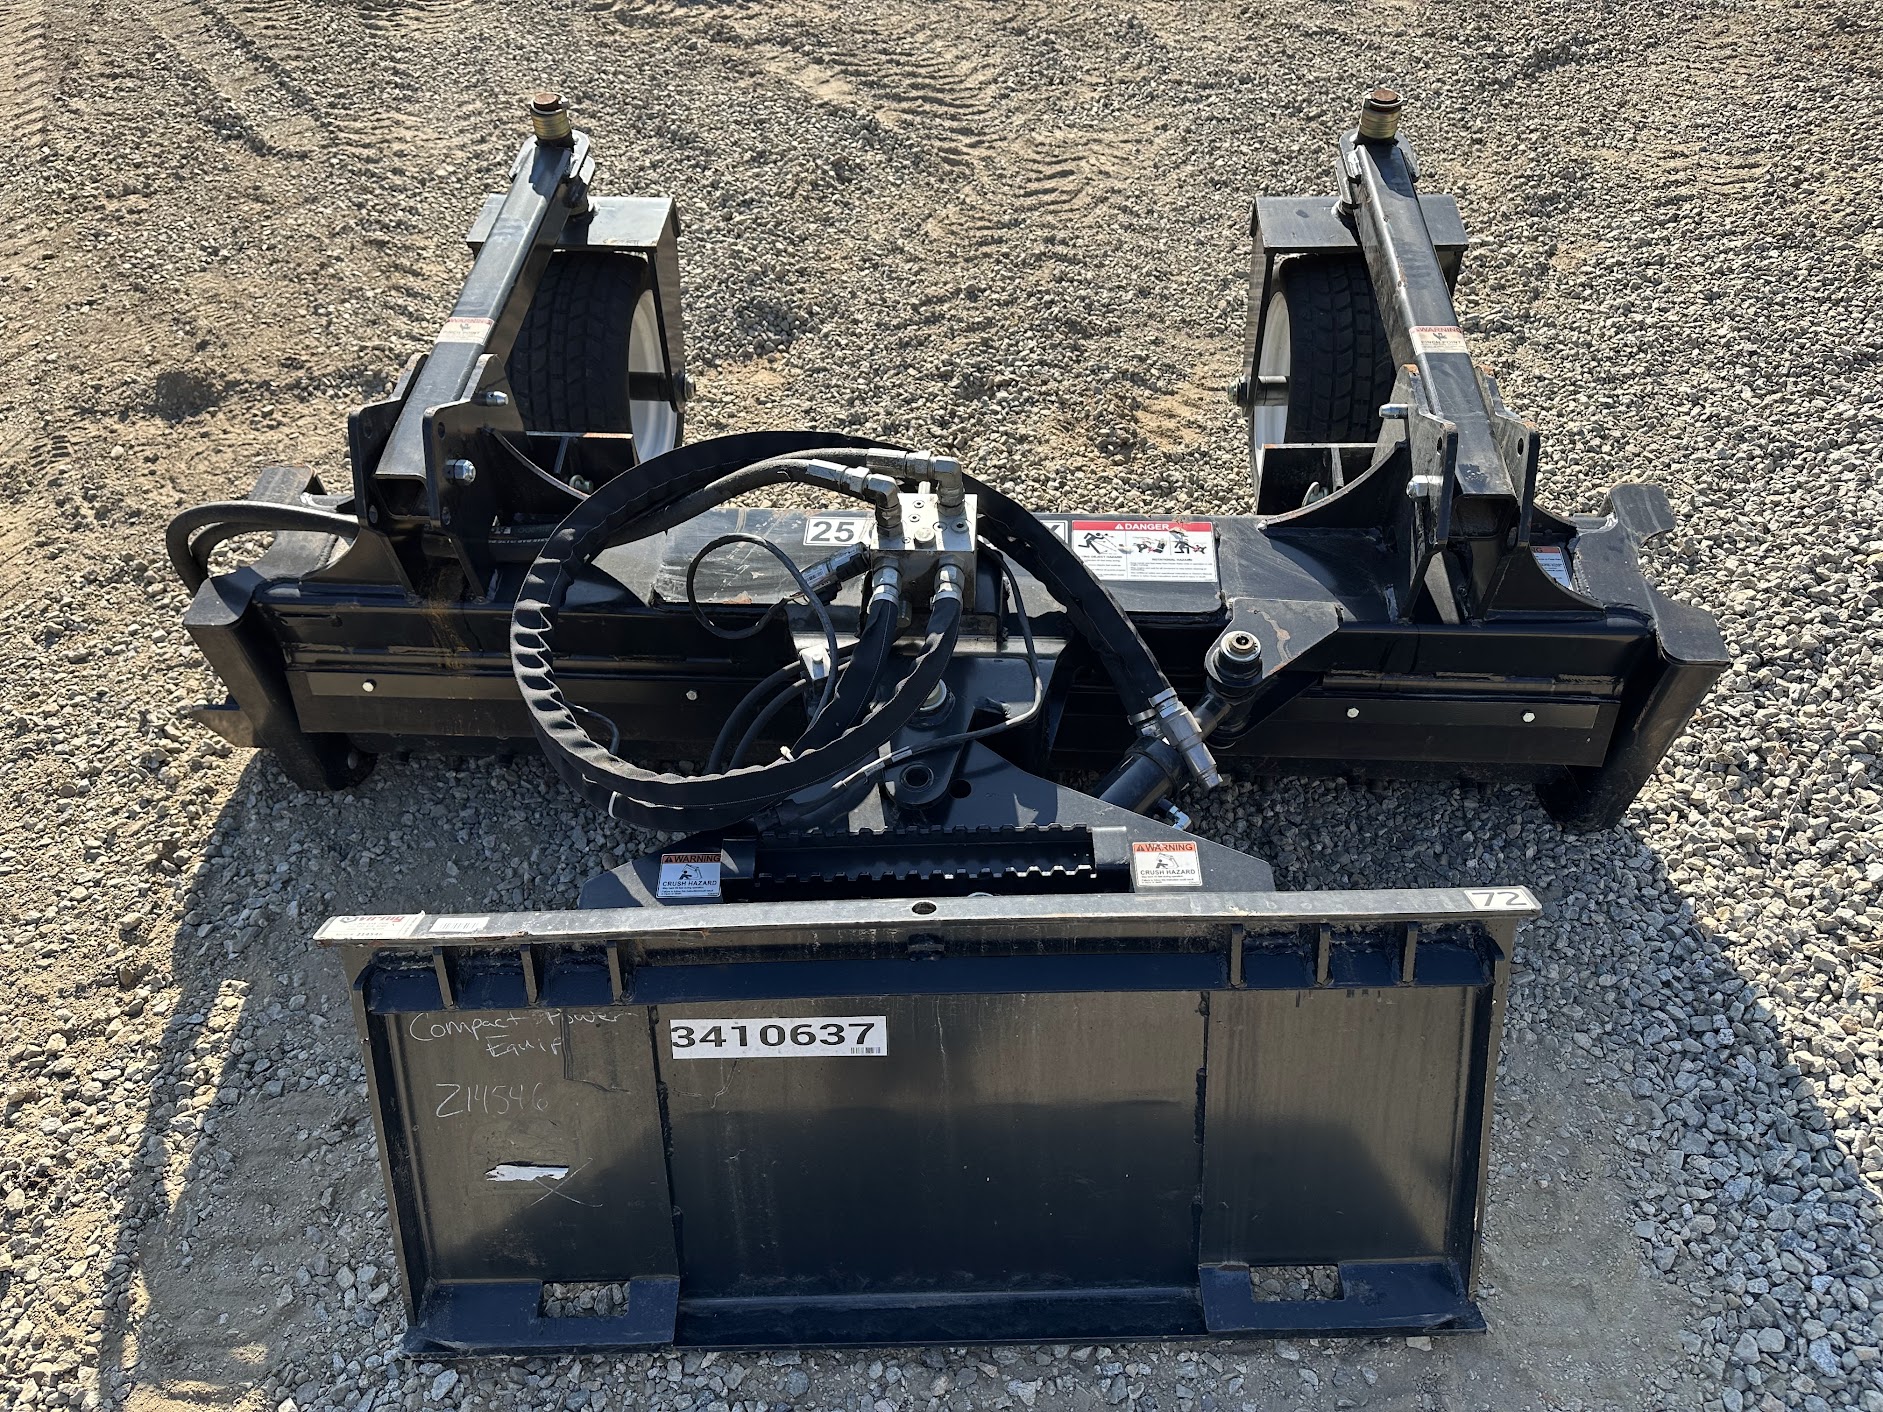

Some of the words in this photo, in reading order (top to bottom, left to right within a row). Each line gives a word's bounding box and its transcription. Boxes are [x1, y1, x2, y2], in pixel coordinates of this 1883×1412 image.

[810, 520, 855, 542] 25
[1145, 843, 1193, 852] WARNING
[674, 854, 721, 863] WARNING
[1471, 891, 1528, 907] 72
[409, 1011, 527, 1041] Compact
[671, 1022, 876, 1049] 3410637
